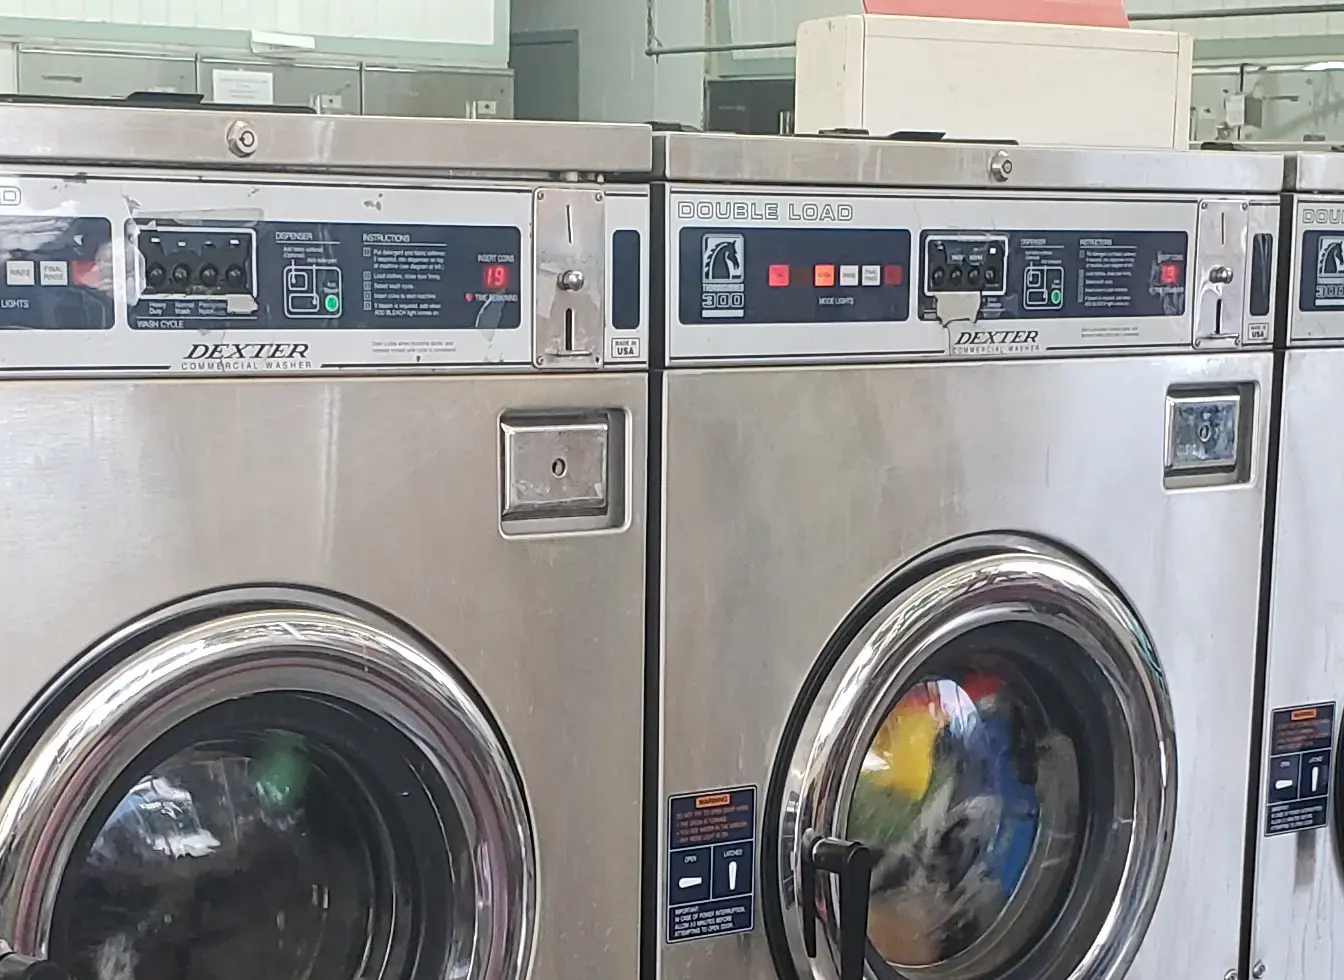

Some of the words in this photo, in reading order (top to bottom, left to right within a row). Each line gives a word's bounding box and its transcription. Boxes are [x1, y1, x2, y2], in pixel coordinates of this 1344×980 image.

[678, 201, 779, 220] DOUBLE
[789, 204, 853, 221] LOAD
[276, 232, 313, 240] DISPENSER
[362, 234, 410, 242] INSTRUCTIONS
[43, 272, 64, 281] RINSE
[487, 268, 504, 285] 19
[1, 299, 30, 308] LIGHTS
[702, 293, 744, 308] 300
[137, 320, 159, 328] WASH
[161, 320, 184, 328] CYCLE
[954, 331, 1038, 345] DEXTER
[183, 343, 309, 360] DEXTER
[617, 347, 634, 355] USA
[953, 346, 1003, 354] COMMERCIAL
[181, 362, 258, 371] COMMERCIAL
